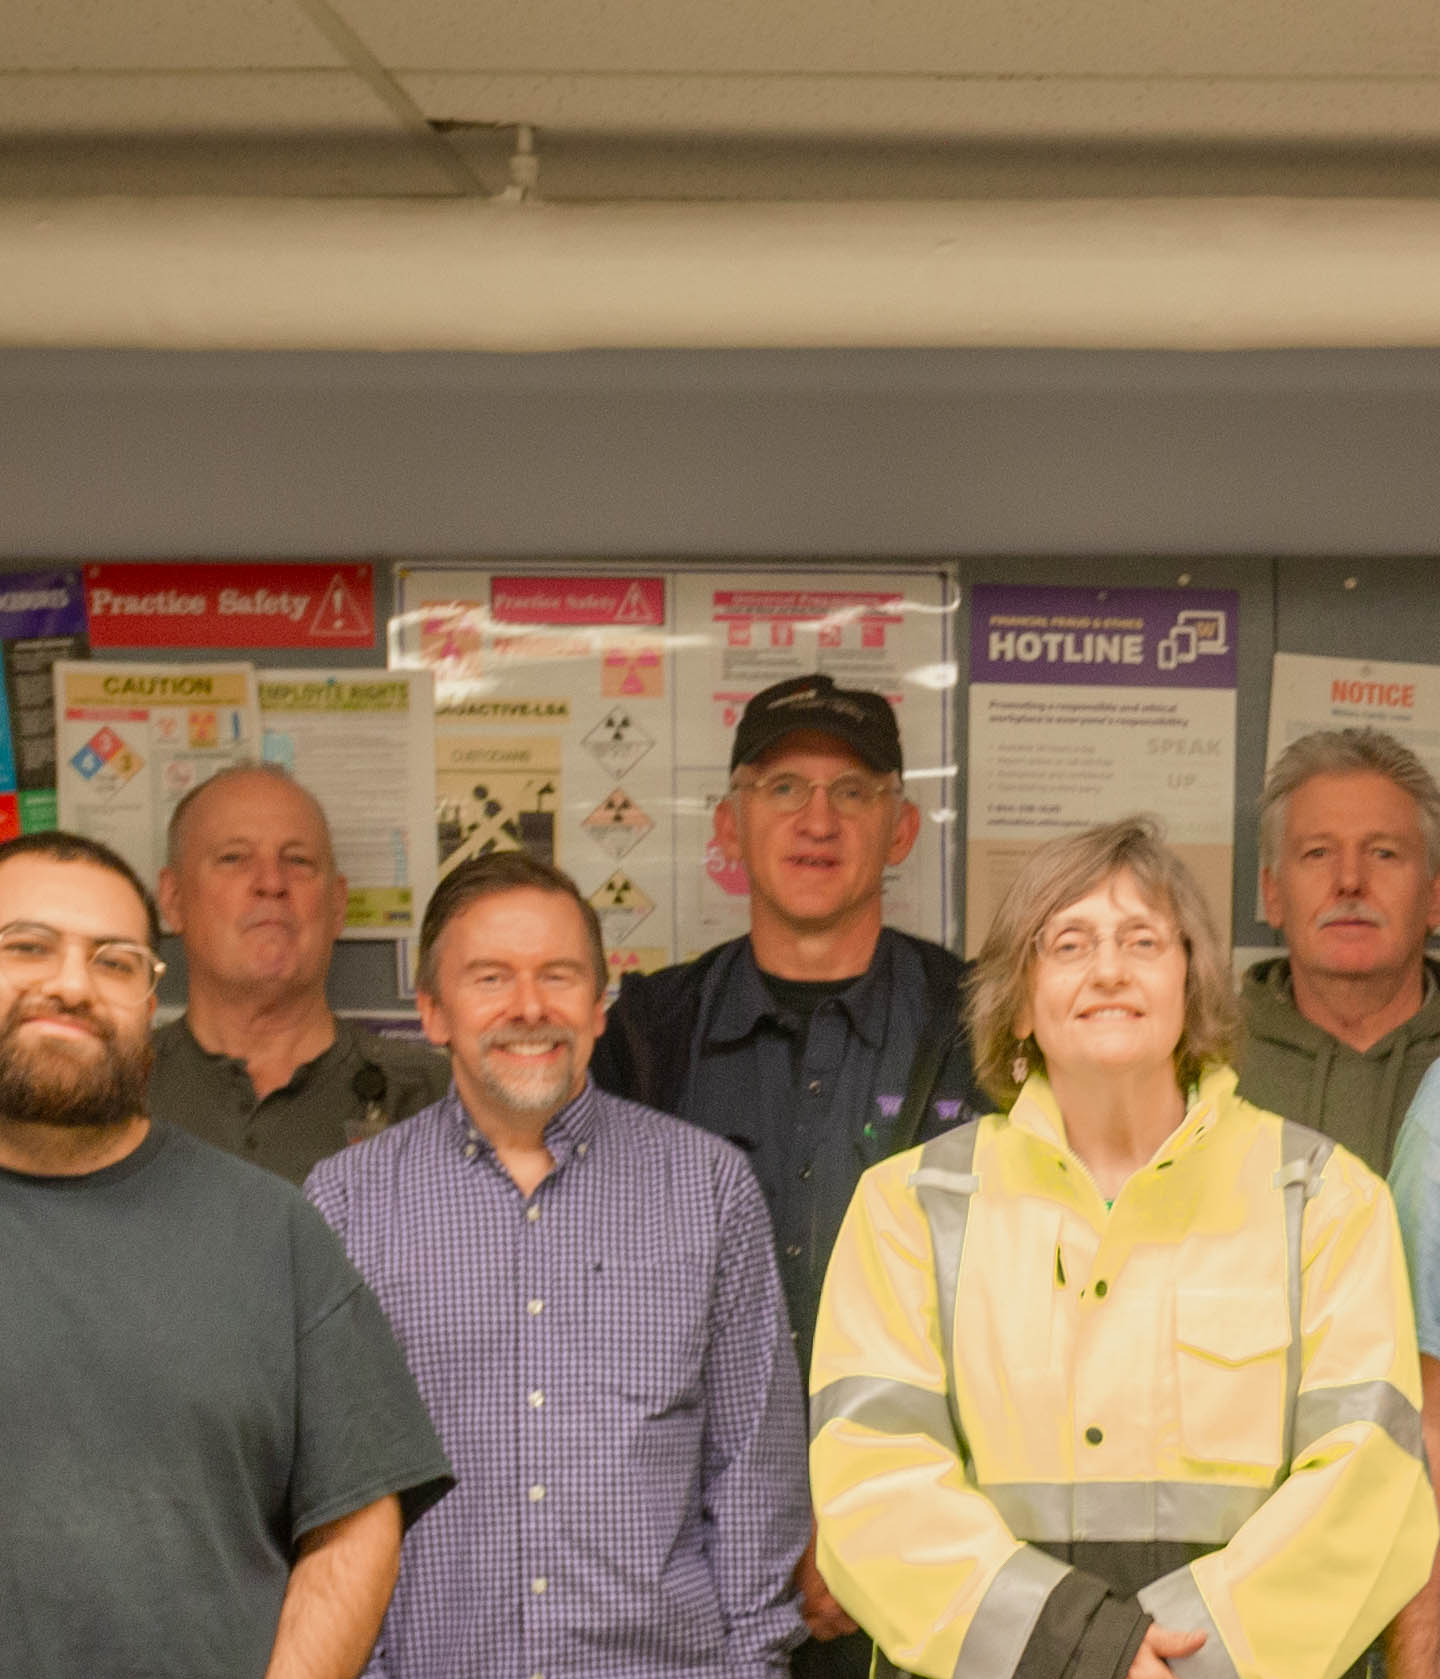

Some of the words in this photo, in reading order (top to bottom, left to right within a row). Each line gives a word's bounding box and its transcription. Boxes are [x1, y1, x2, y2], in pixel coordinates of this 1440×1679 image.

[90, 588, 206, 616] Practice
[217, 588, 310, 621] Safety
[988, 632, 1144, 664] HOTLINE
[102, 675, 213, 696] CAUTION
[1330, 679, 1415, 708] NOTICE
